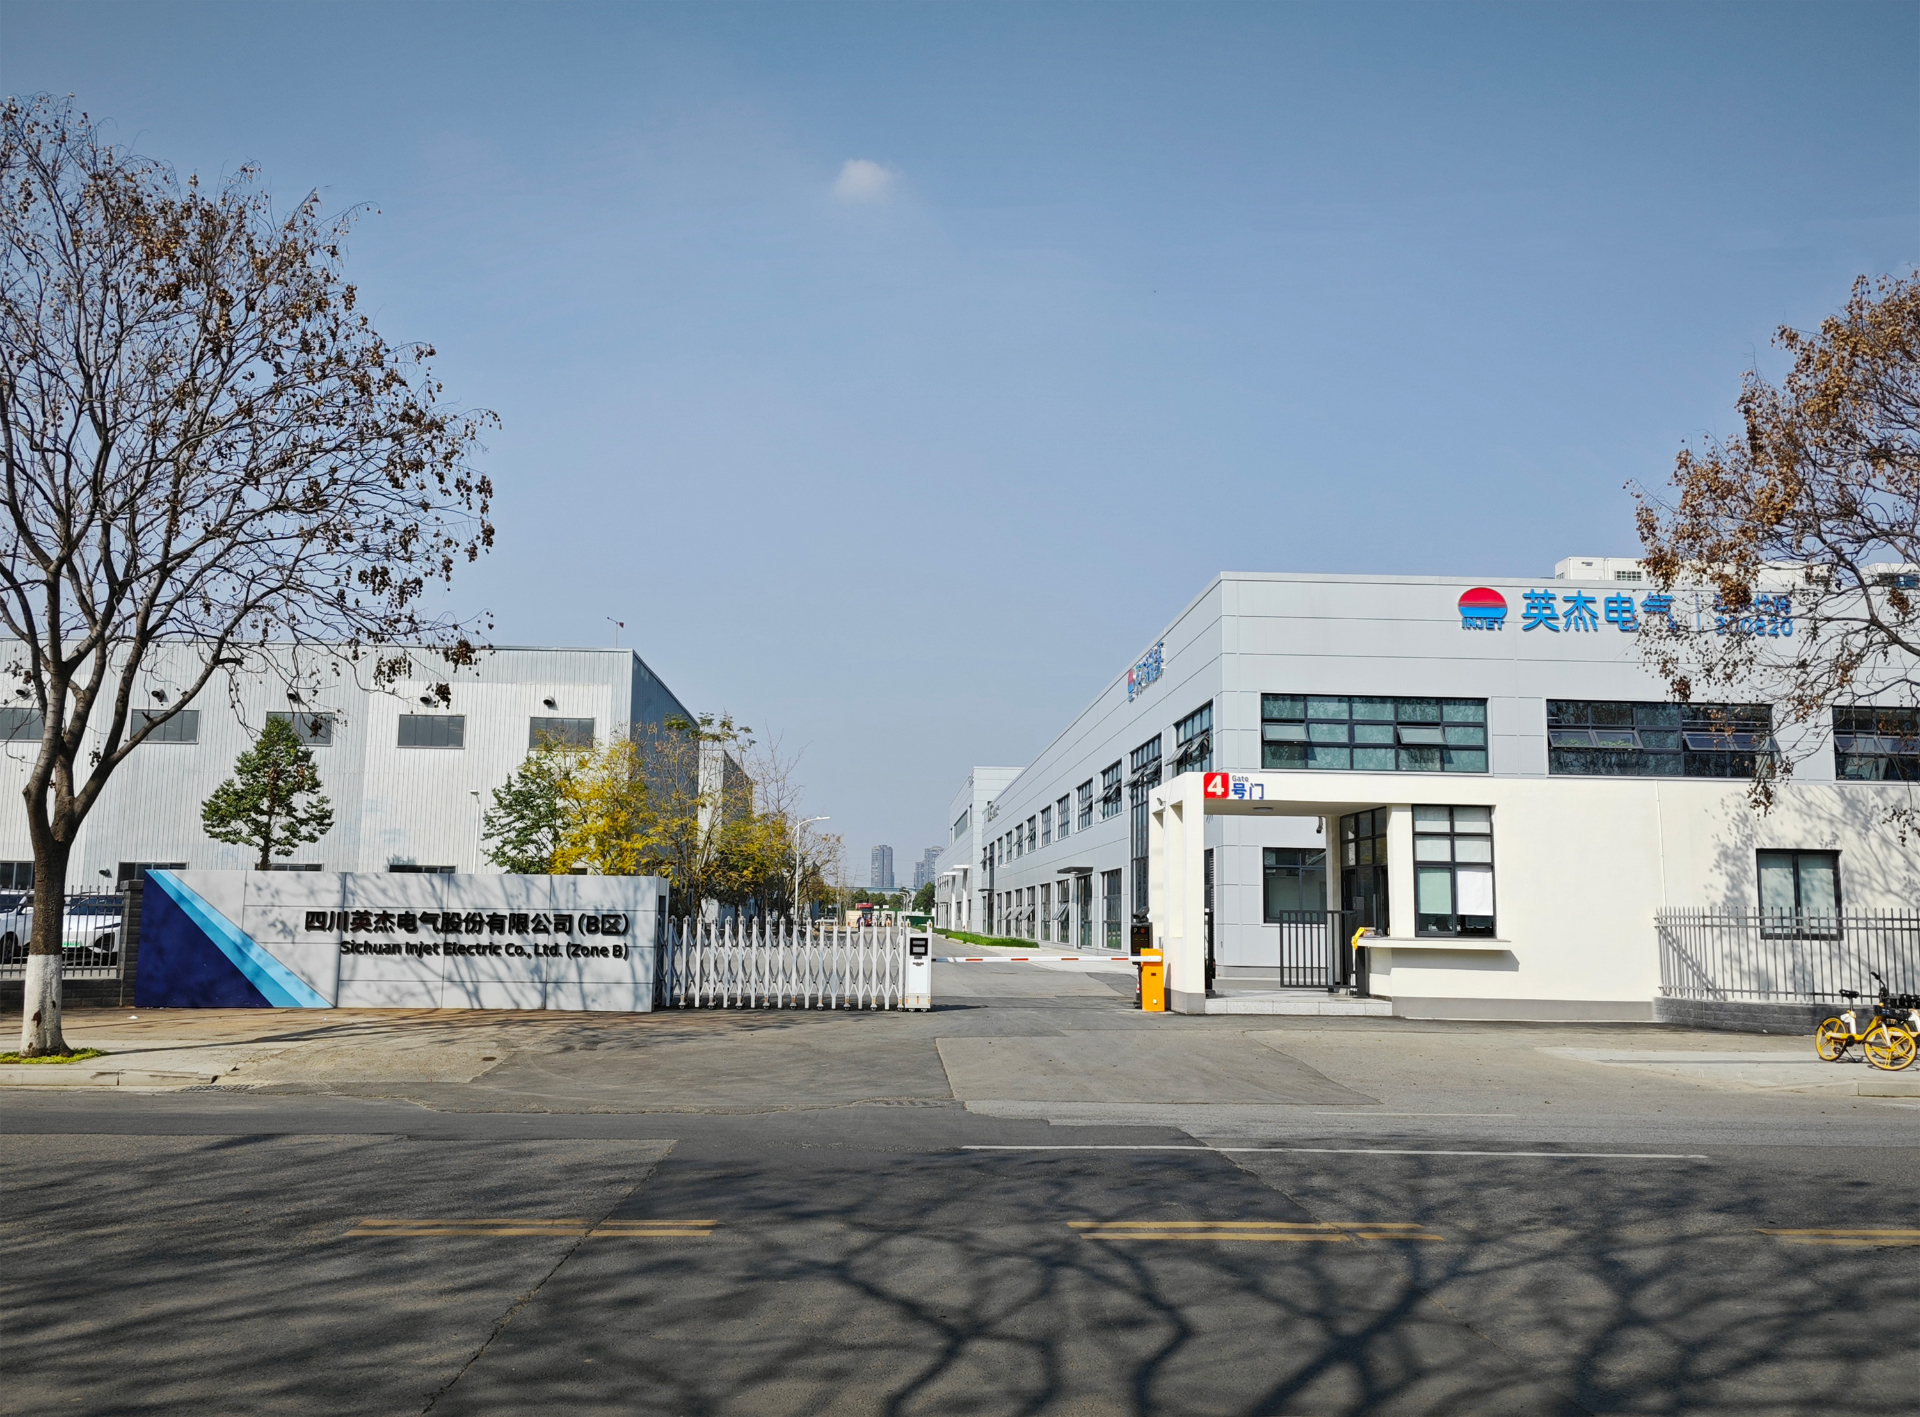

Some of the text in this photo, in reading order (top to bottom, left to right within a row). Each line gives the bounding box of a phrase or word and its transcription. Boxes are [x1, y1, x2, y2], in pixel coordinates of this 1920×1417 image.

[1522, 588, 1678, 632] 英杰电气
[1461, 617, 1505, 631] INJET
[1207, 774, 1265, 800] 4 号门
[1231, 774, 1250, 783] Gate
[340, 940, 402, 956] Sichuan
[405, 941, 440, 959] Injet
[443, 941, 502, 957] Electric
[566, 942, 610, 960] (Zone
[612, 943, 630, 961] B)
